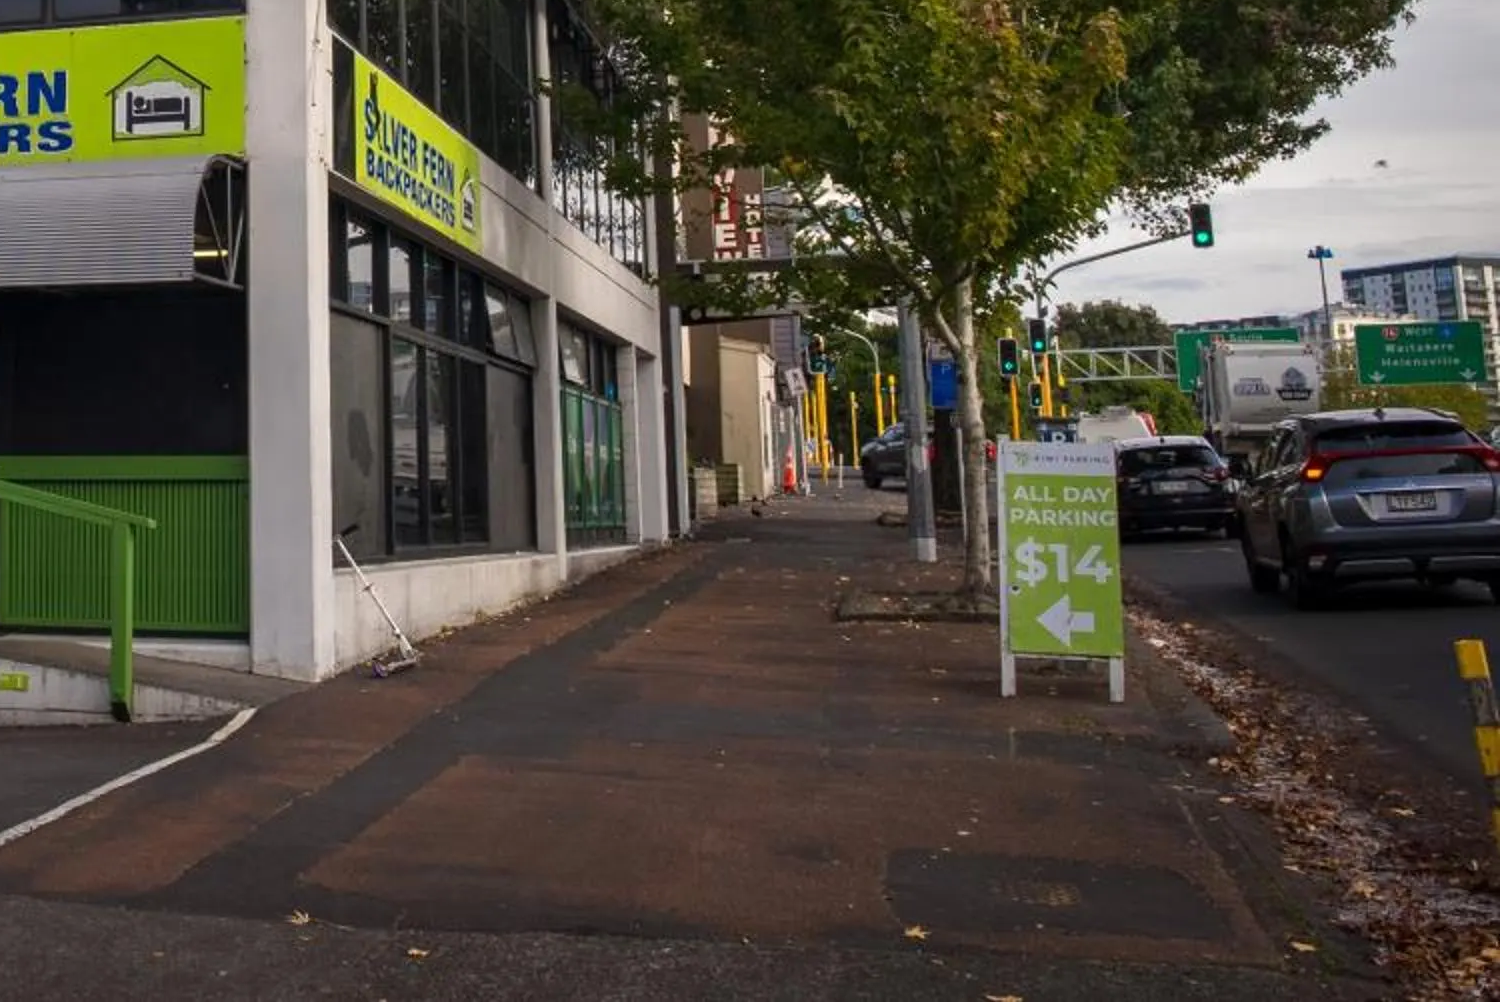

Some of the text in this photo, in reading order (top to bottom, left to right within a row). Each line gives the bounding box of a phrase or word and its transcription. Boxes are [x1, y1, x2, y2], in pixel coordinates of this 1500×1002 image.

[422, 141, 455, 195] FERN
[365, 146, 457, 228] BACKPACKERS
[1384, 342, 1455, 353] Waitakere
[1381, 356, 1461, 368] Helensville
[1063, 455, 1110, 464] PARKING
[1013, 485, 1112, 504] ALL DAY
[1009, 508, 1117, 527] PARKING
[1015, 536, 1113, 587] $14
